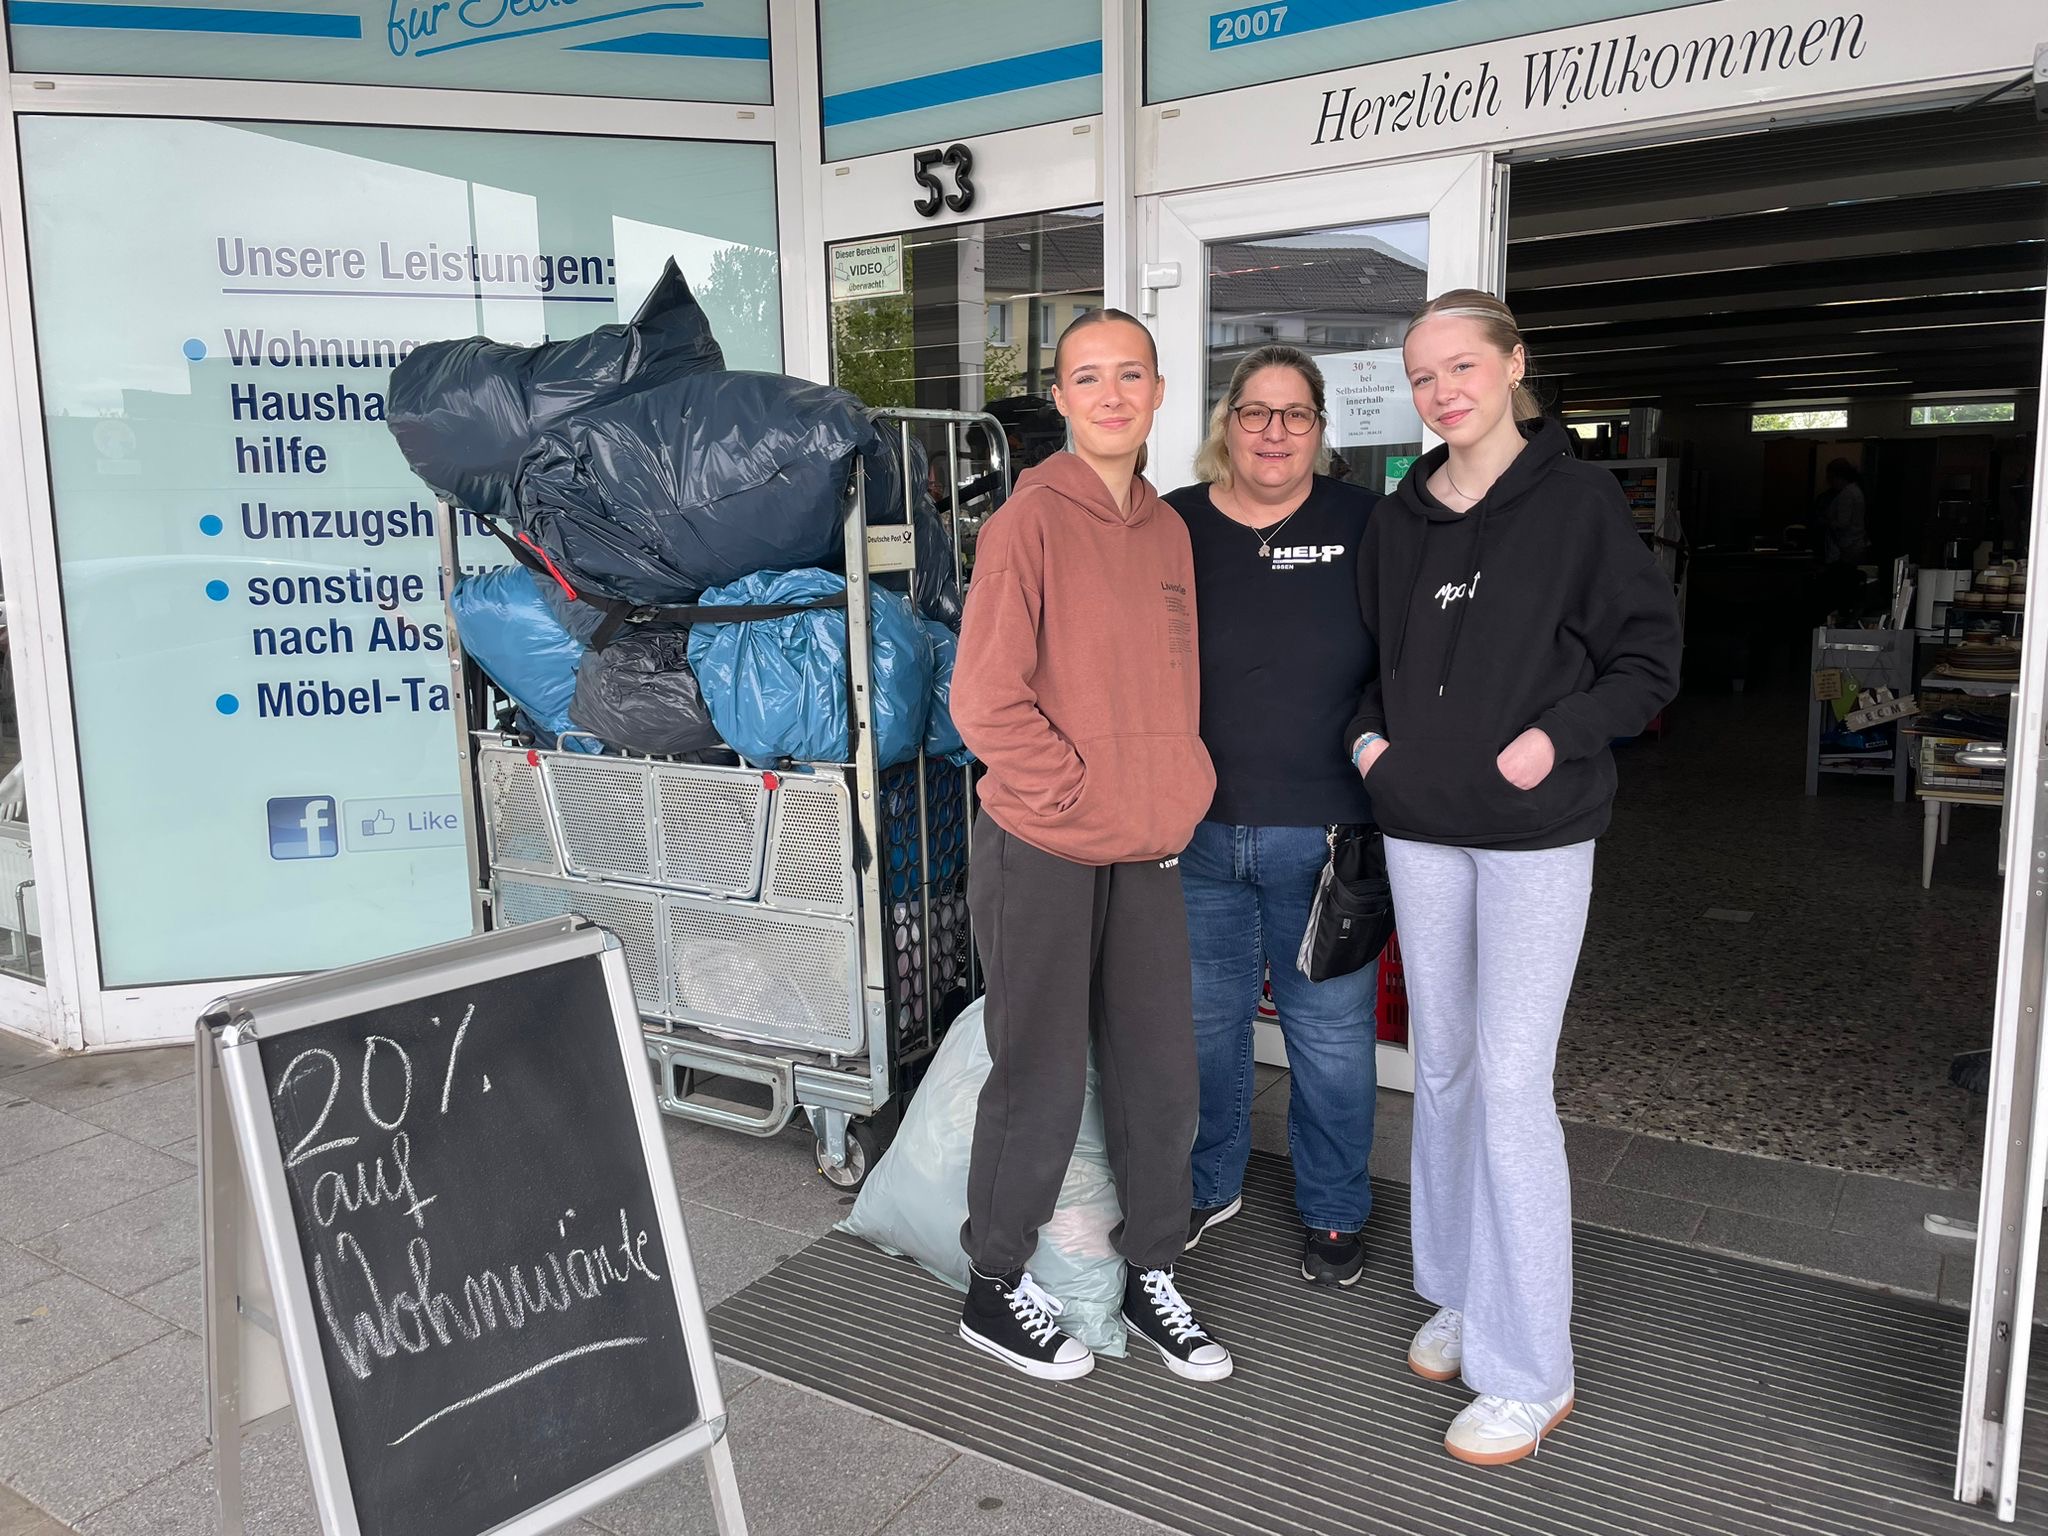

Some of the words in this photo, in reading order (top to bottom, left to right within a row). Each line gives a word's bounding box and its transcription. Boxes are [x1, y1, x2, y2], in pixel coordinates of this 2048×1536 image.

[1216, 6, 1289, 44] 2007
[1310, 61, 1502, 146] Herzlich
[1524, 13, 1867, 110] Willkommen
[913, 142, 976, 218] 53
[835, 250, 855, 260] Dieser
[856, 246, 880, 256] Bereich
[881, 243, 896, 253] wird
[216, 236, 367, 280] Unsere
[380, 240, 617, 292] Leistungen:
[849, 262, 883, 277] VIDEO
[848, 279, 885, 292] überwacht!
[1352, 361, 1364, 372] 30
[1360, 374, 1372, 383] bei
[1335, 384, 1395, 396] Selbstabholung
[230, 383, 387, 421] Hausha
[1346, 396, 1384, 406] innerhalb
[1349, 409, 1355, 417] 3
[1356, 408, 1381, 417] Tagen
[235, 436, 328, 474] hilfe
[891, 534, 902, 543] Post
[1273, 545, 1345, 563] HELP
[248, 567, 424, 611] sonstige
[253, 618, 353, 656] nach
[368, 616, 446, 653] Abs
[257, 677, 451, 718] Möbel-Ta
[1855, 702, 1906, 724] WELCOME
[407, 810, 458, 831] Like
[312, 1130, 437, 1228] auf
